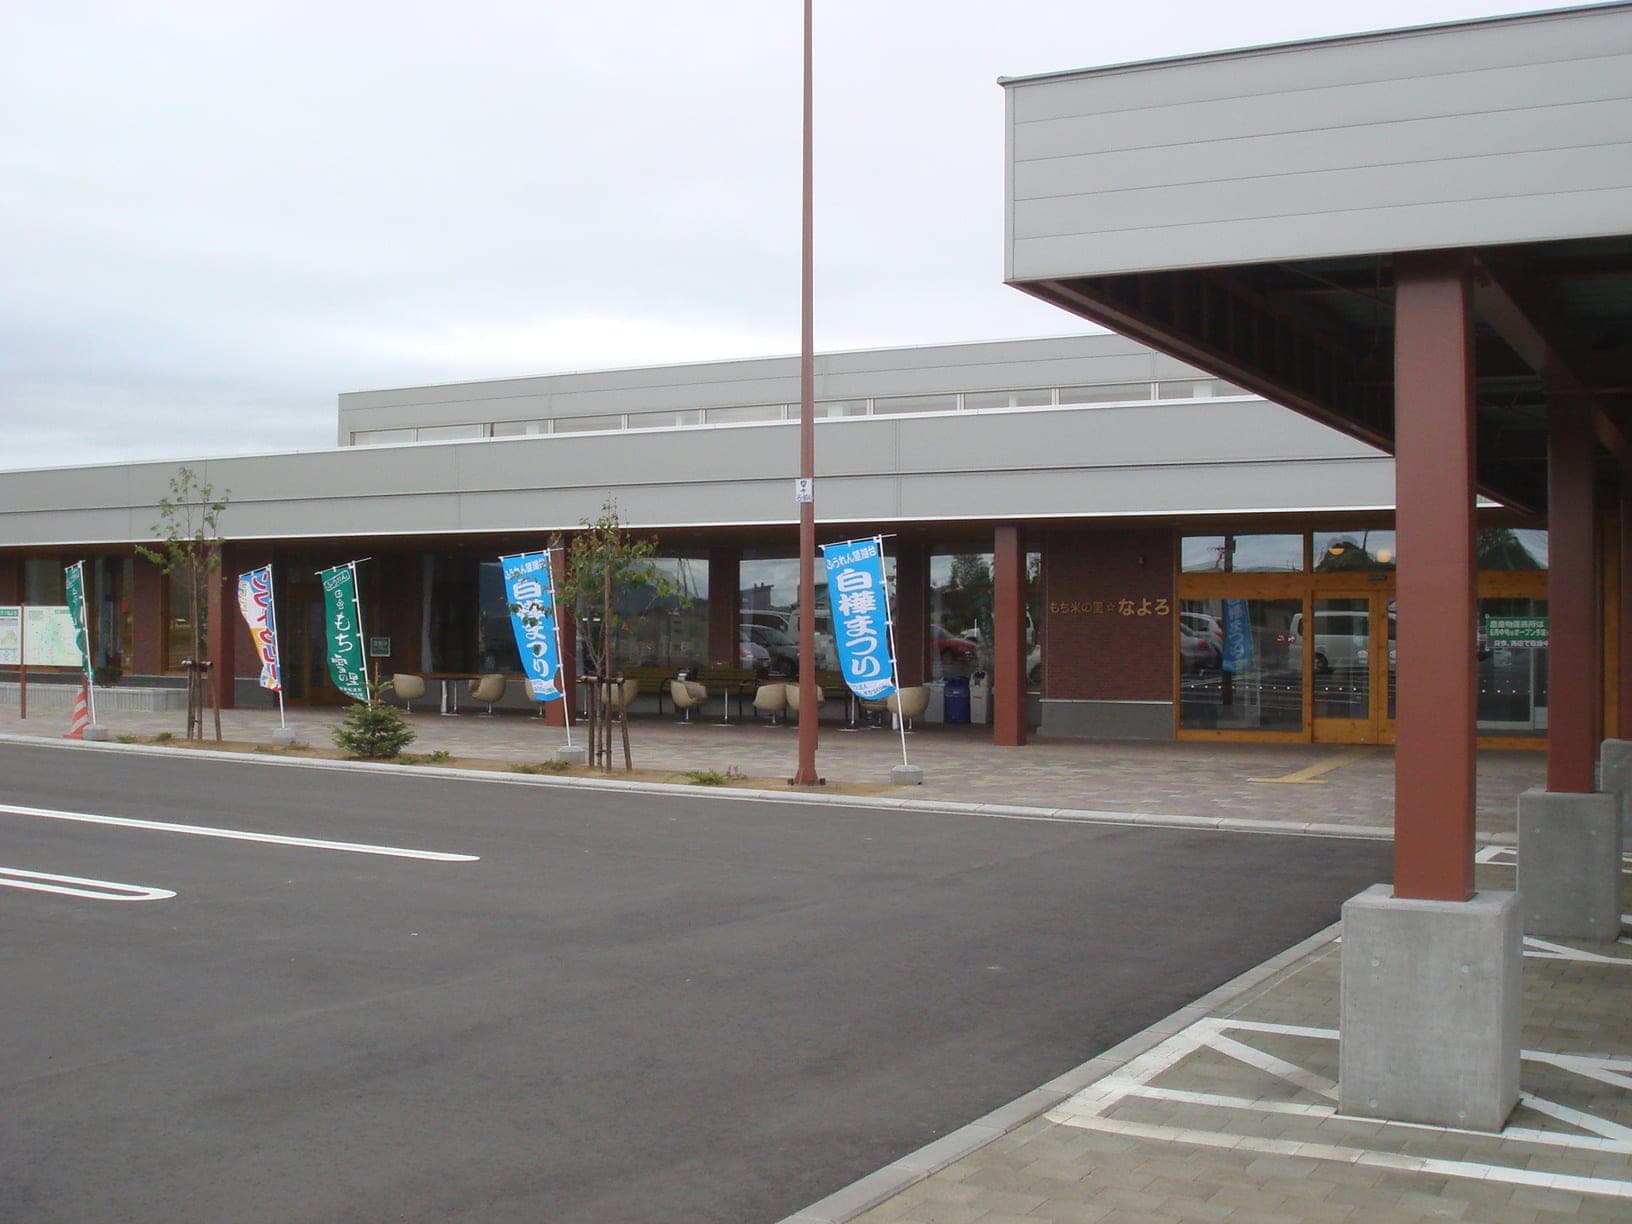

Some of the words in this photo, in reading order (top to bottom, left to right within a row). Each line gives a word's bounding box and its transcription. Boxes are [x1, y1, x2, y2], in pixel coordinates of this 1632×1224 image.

[836, 568, 881, 677] 白樺まつり
[1118, 598, 1170, 616] なよろ
